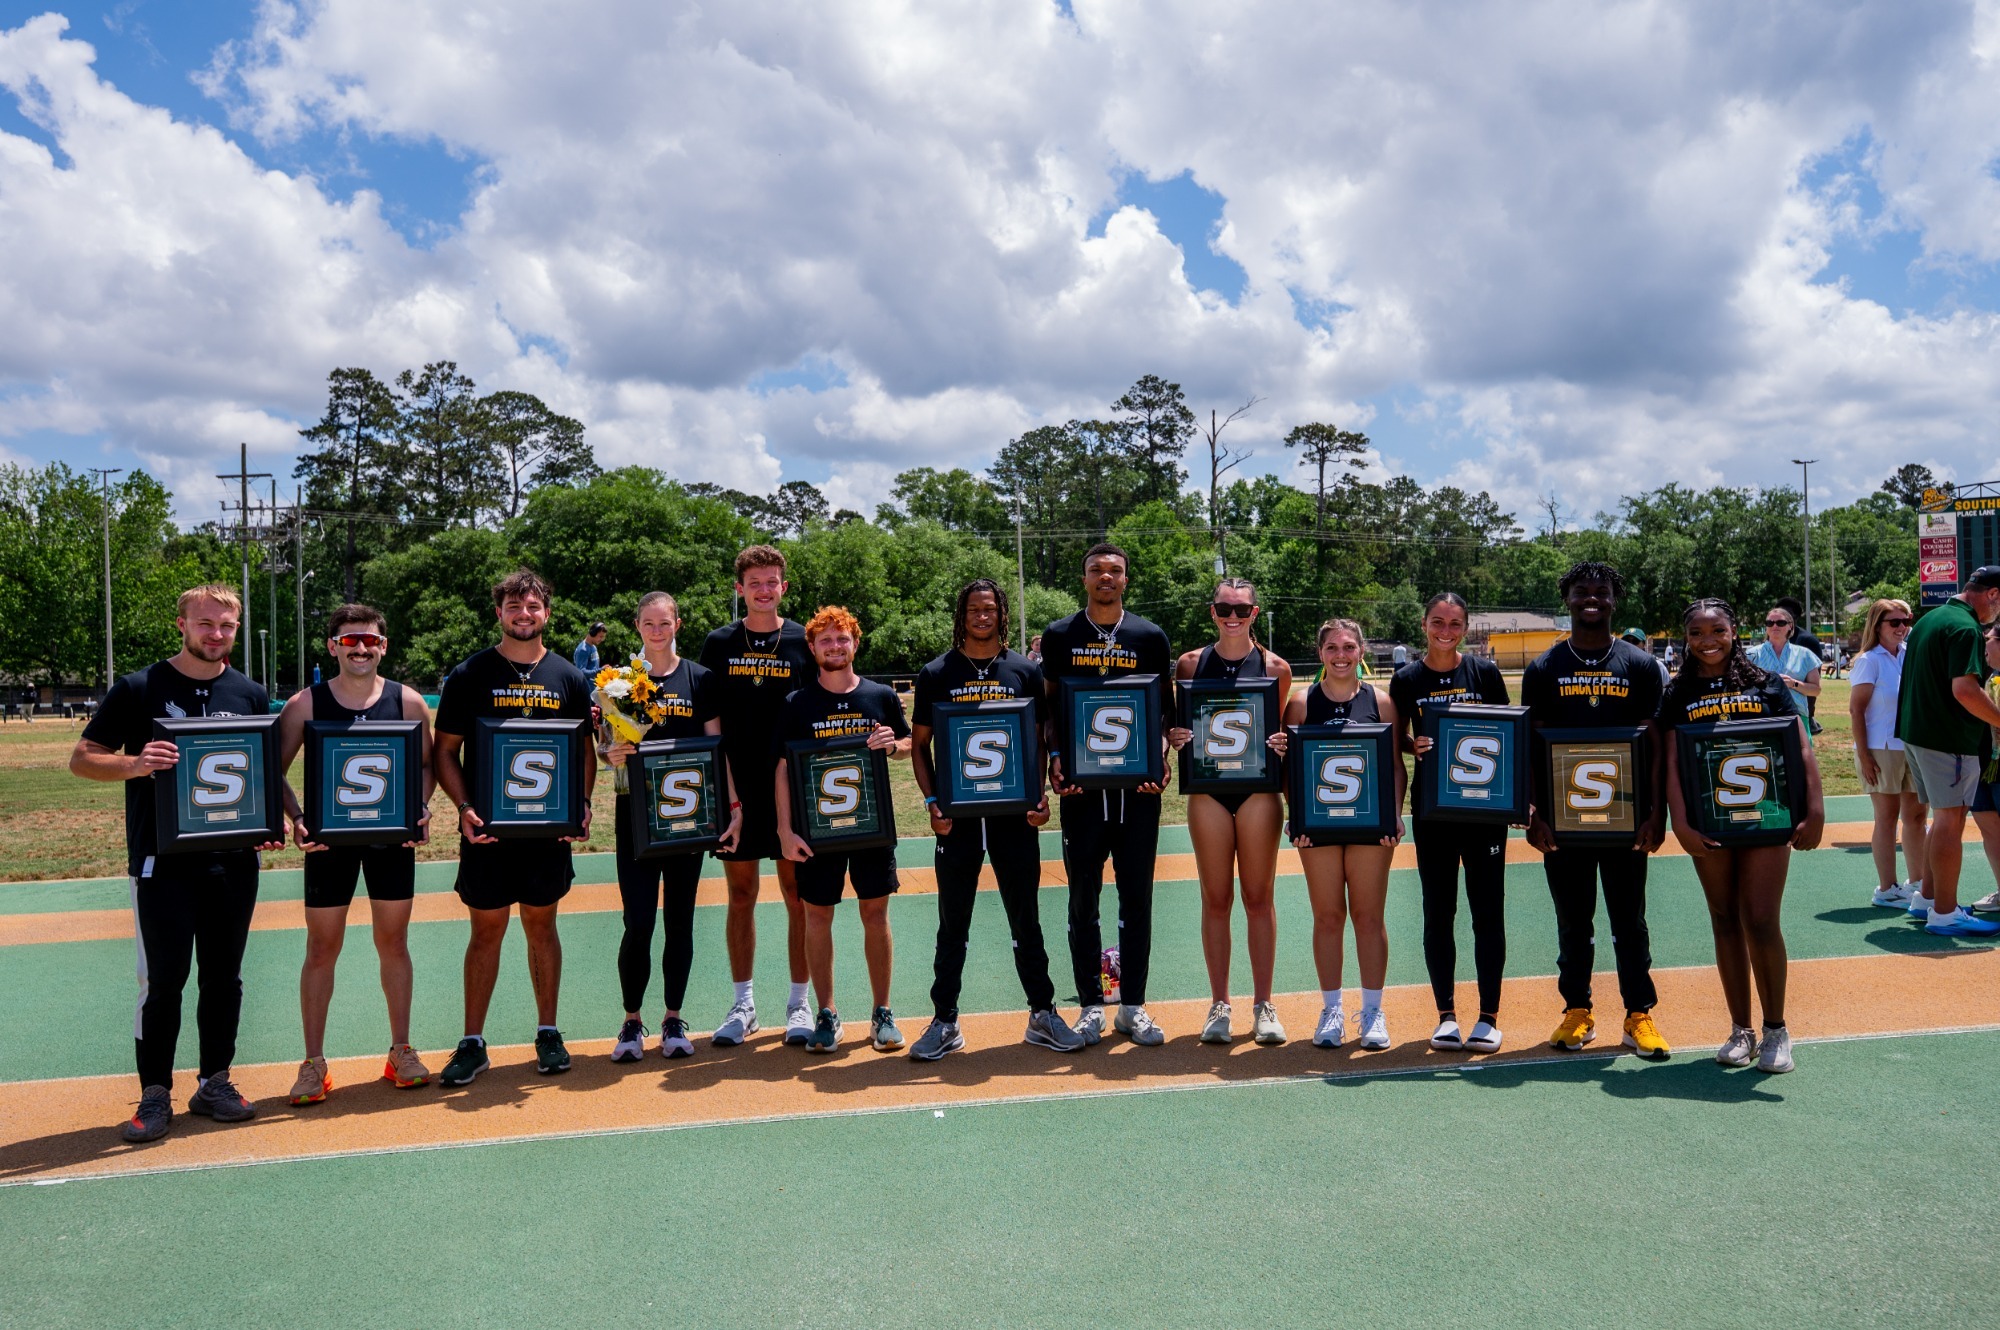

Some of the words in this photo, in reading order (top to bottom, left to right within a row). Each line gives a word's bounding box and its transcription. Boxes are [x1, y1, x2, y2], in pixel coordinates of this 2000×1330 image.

[729, 658, 758, 675] TRACK
[766, 660, 790, 678] FIELD
[1072, 648, 1102, 666] TRACK
[1110, 649, 1136, 668] FIELD
[492, 688, 526, 707] TRACK
[534, 690, 560, 709] FIELD
[1558, 677, 1592, 696] TRACK
[1600, 677, 1629, 697] FIELD
[1686, 698, 1721, 721] TRACK
[1730, 695, 1762, 713] FIELD
[1087, 706, 1133, 752] S
[1205, 710, 1252, 757] S
[192, 751, 249, 806] S
[505, 750, 556, 799] S
[963, 730, 1009, 779] S
[1449, 736, 1500, 784] S
[336, 754, 391, 805] S
[659, 769, 702, 818] S
[818, 766, 861, 815] S
[1316, 755, 1365, 803] S
[1567, 760, 1618, 809] S
[1716, 753, 1769, 806] S
